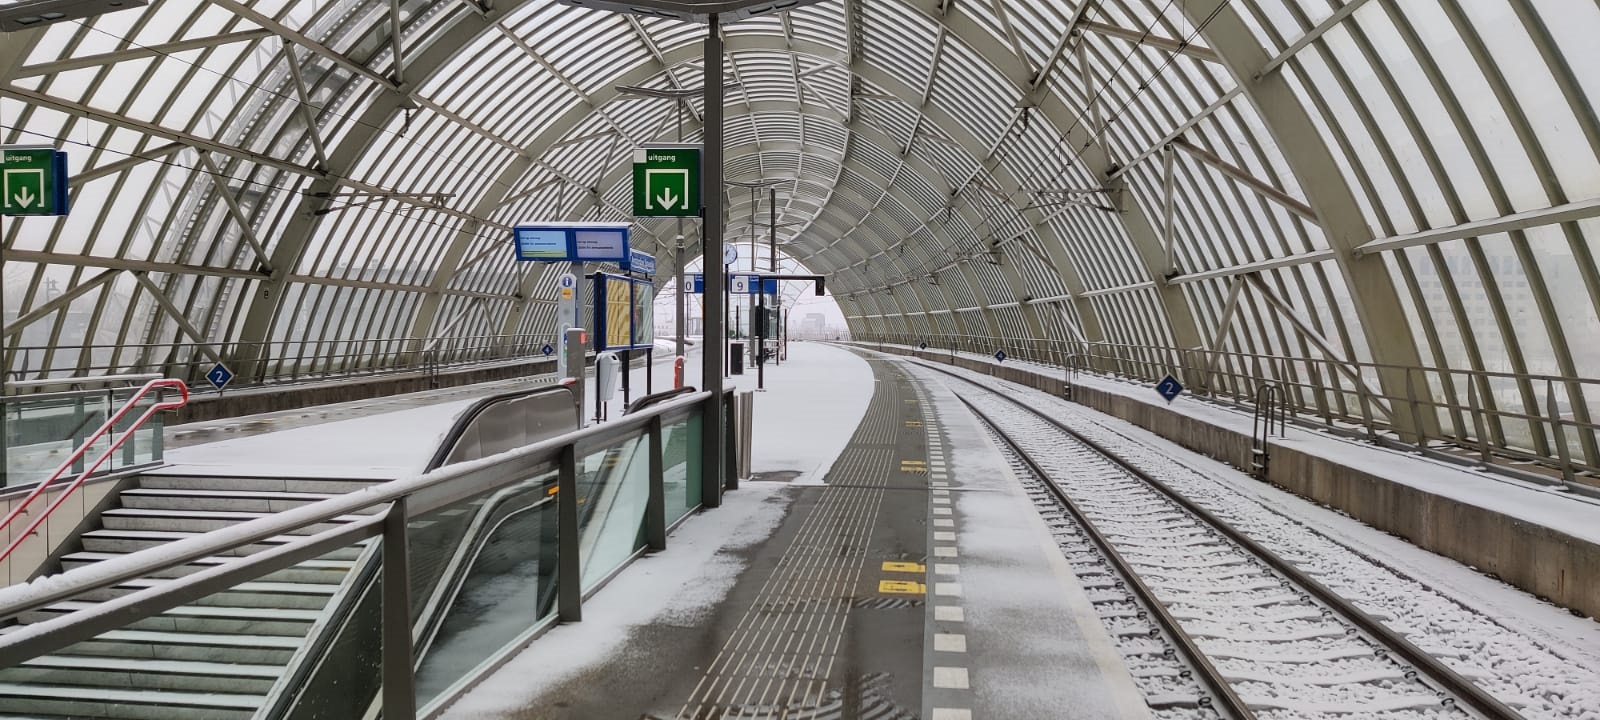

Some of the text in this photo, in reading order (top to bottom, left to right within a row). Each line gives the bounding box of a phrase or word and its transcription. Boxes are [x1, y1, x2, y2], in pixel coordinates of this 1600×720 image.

[6, 154, 32, 162] uitgang
[648, 153, 676, 162] uitgang
[736, 281, 744, 291] 9
[215, 370, 224, 383] 2
[1165, 382, 1174, 395] 2
